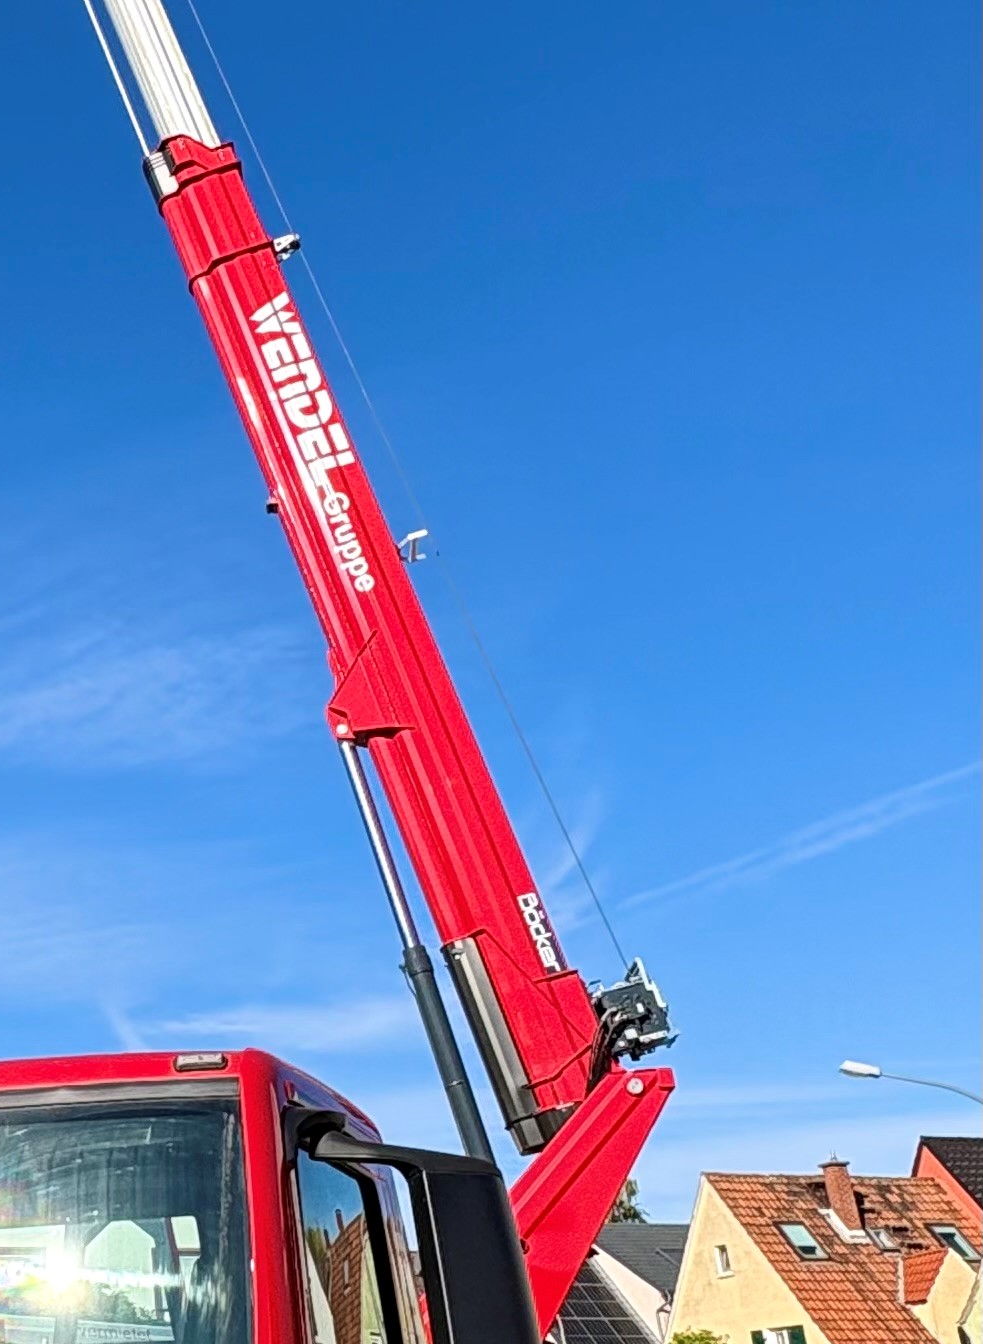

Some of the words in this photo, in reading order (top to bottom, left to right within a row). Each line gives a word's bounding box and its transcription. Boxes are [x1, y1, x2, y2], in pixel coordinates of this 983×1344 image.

[249, 290, 355, 488] WENDEL
[323, 491, 375, 592] Gruppe
[517, 892, 561, 972] Böcker
